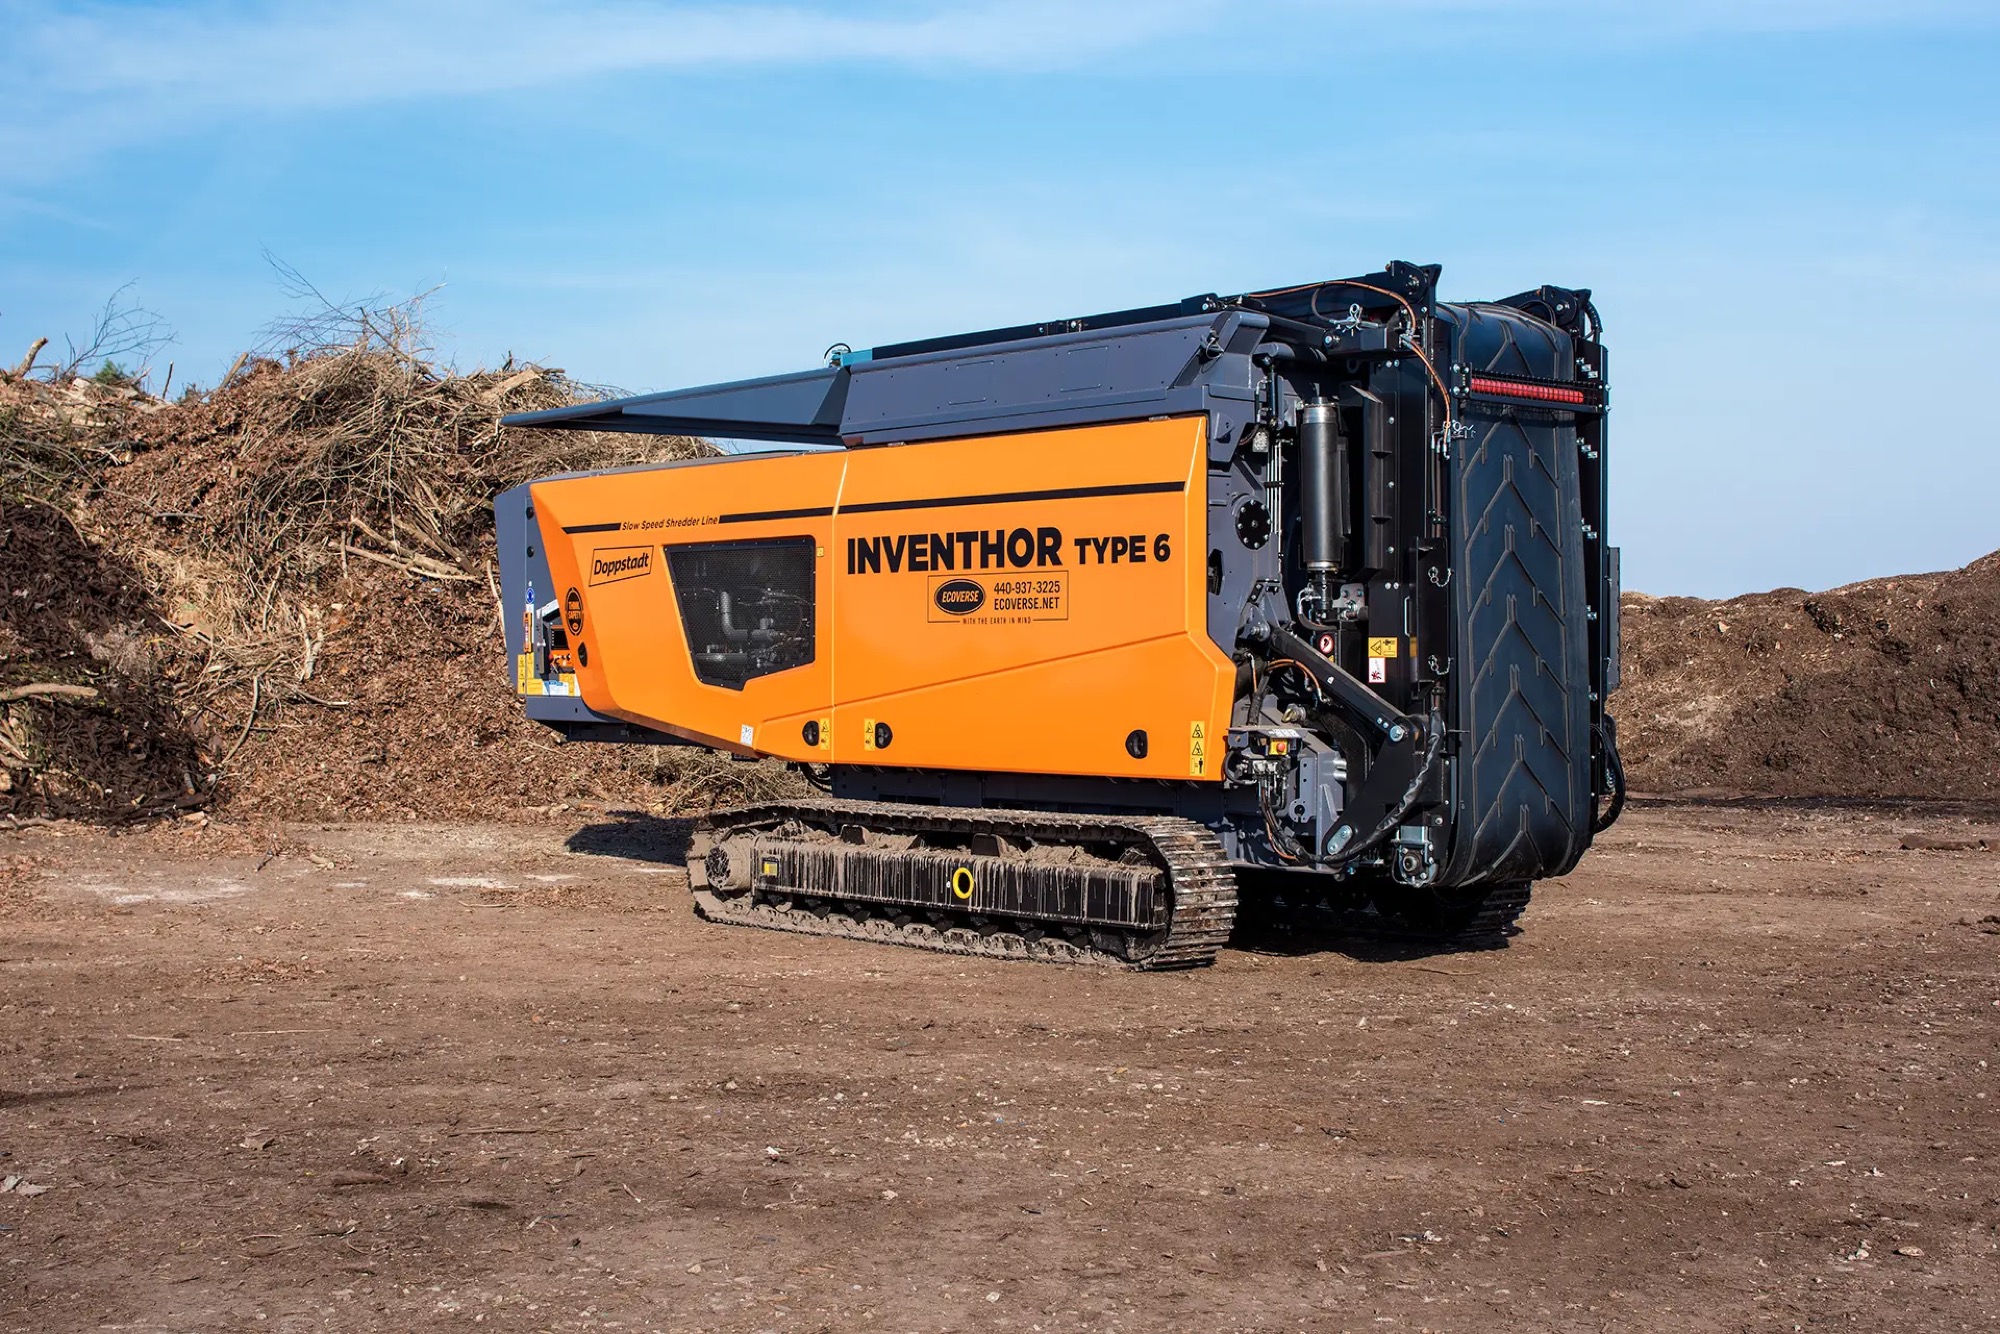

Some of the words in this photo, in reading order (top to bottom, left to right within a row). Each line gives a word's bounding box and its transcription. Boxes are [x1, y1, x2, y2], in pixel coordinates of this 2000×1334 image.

[622, 521, 640, 531] Slow
[641, 519, 665, 531] Speed
[666, 516, 699, 528] Shredder
[701, 515, 718, 526] Line
[848, 527, 1063, 575] INVENTHOR
[1074, 535, 1147, 565] TYPE
[1153, 533, 1171, 562] 6
[594, 552, 649, 577] Doppstadt
[993, 580, 1060, 595] 440-937-3225
[941, 590, 980, 603] ECOVERSE
[994, 597, 1060, 610] ECOVERSE.NET
